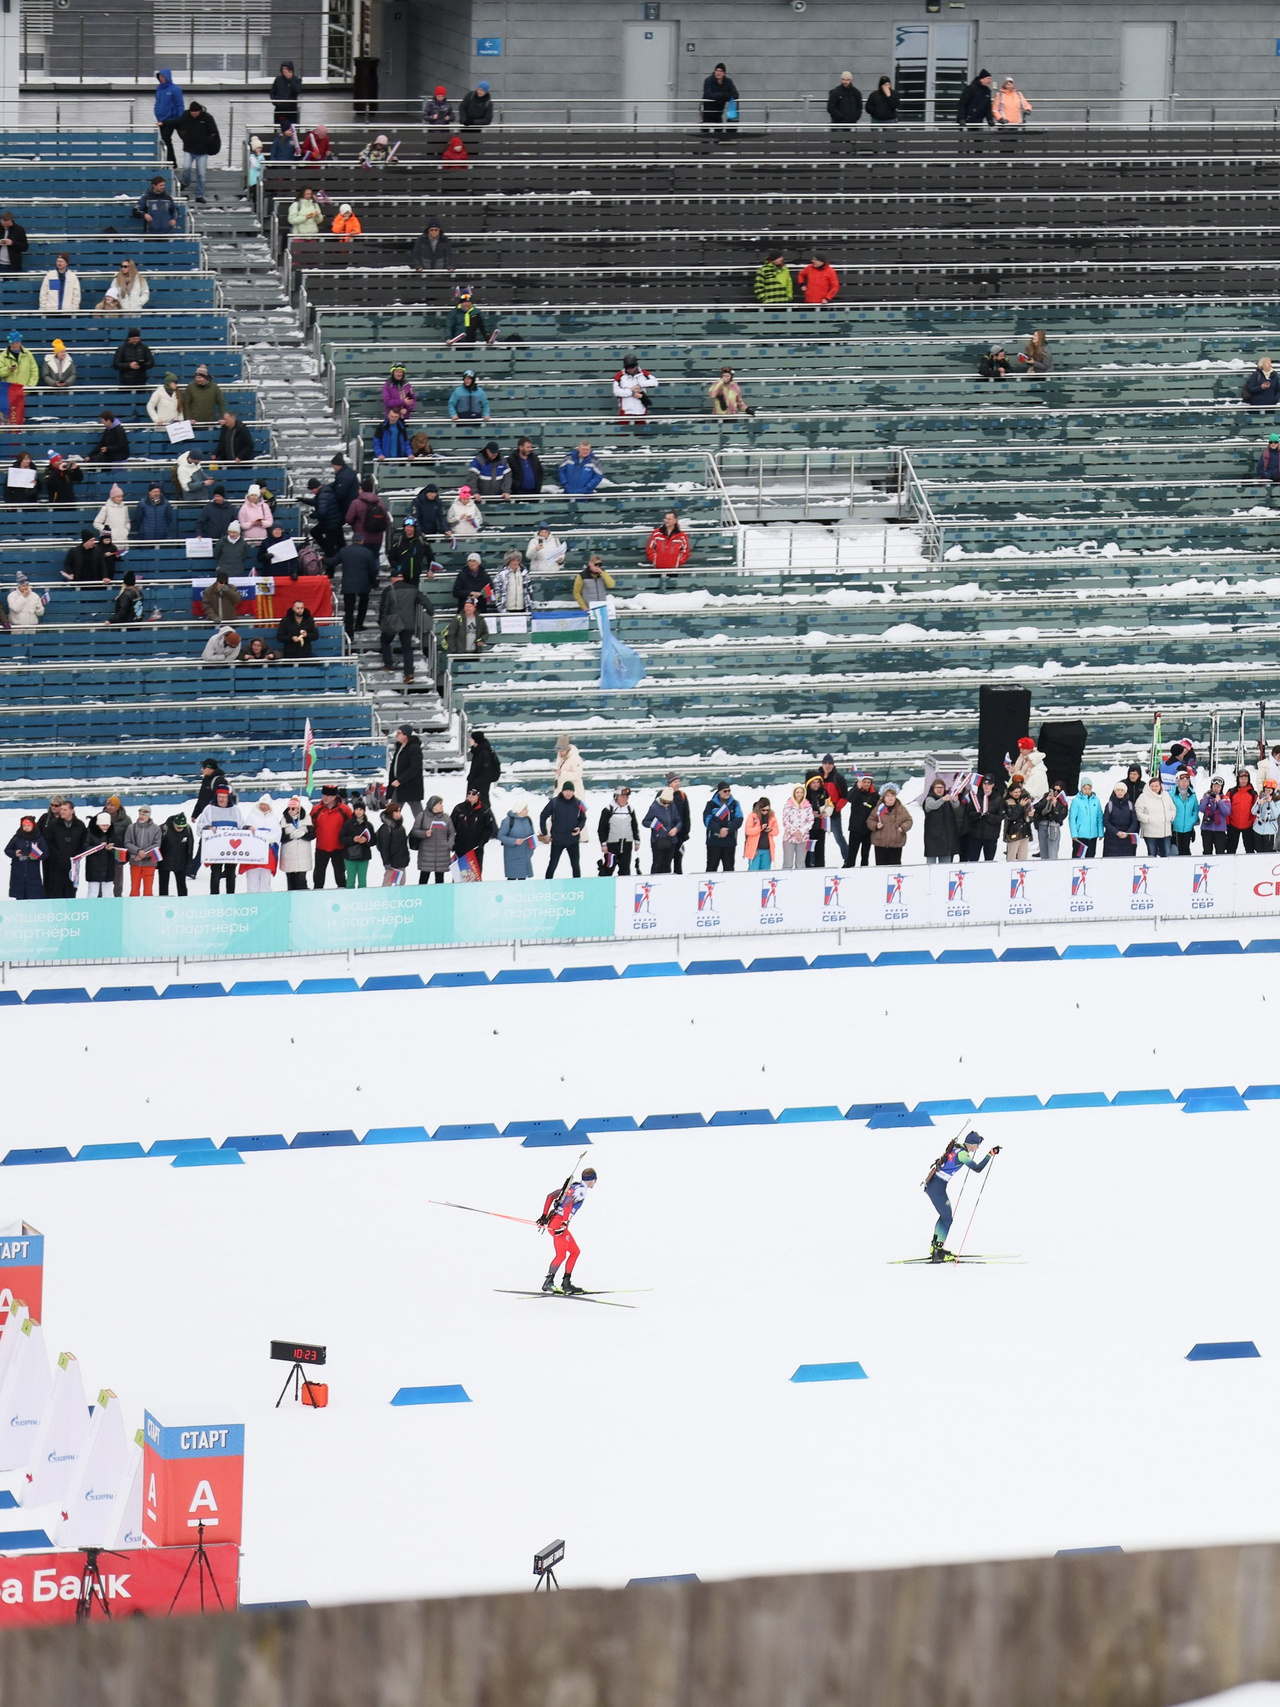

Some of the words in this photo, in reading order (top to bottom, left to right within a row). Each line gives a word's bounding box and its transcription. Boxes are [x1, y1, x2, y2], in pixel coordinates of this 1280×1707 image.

[1008, 906, 1033, 915] СБР
[1069, 904, 1094, 913] СБР
[1130, 902, 1155, 911] СБР
[1191, 901, 1214, 910] СБР
[490, 910, 500, 919] и
[503, 905, 576, 920] партнёры
[884, 911, 909, 920] СБР
[946, 908, 971, 917] СБР
[327, 919, 336, 928] и
[341, 912, 414, 928] партнёры
[696, 918, 721, 928] СБР
[759, 916, 784, 925] СБР
[822, 913, 847, 923] СБР
[160, 926, 170, 934] и
[175, 921, 249, 937] партнёры
[633, 921, 657, 930] СБР
[4, 925, 81, 942] партнёры
[0, 1241, 30, 1259] АРТ
[293, 1348, 317, 1361] 10:23
[147, 1418, 161, 1447] СТАРТ
[180, 1430, 229, 1450] СТАРТ
[0, 1578, 24, 1604] а
[32, 1568, 132, 1603] Банк
